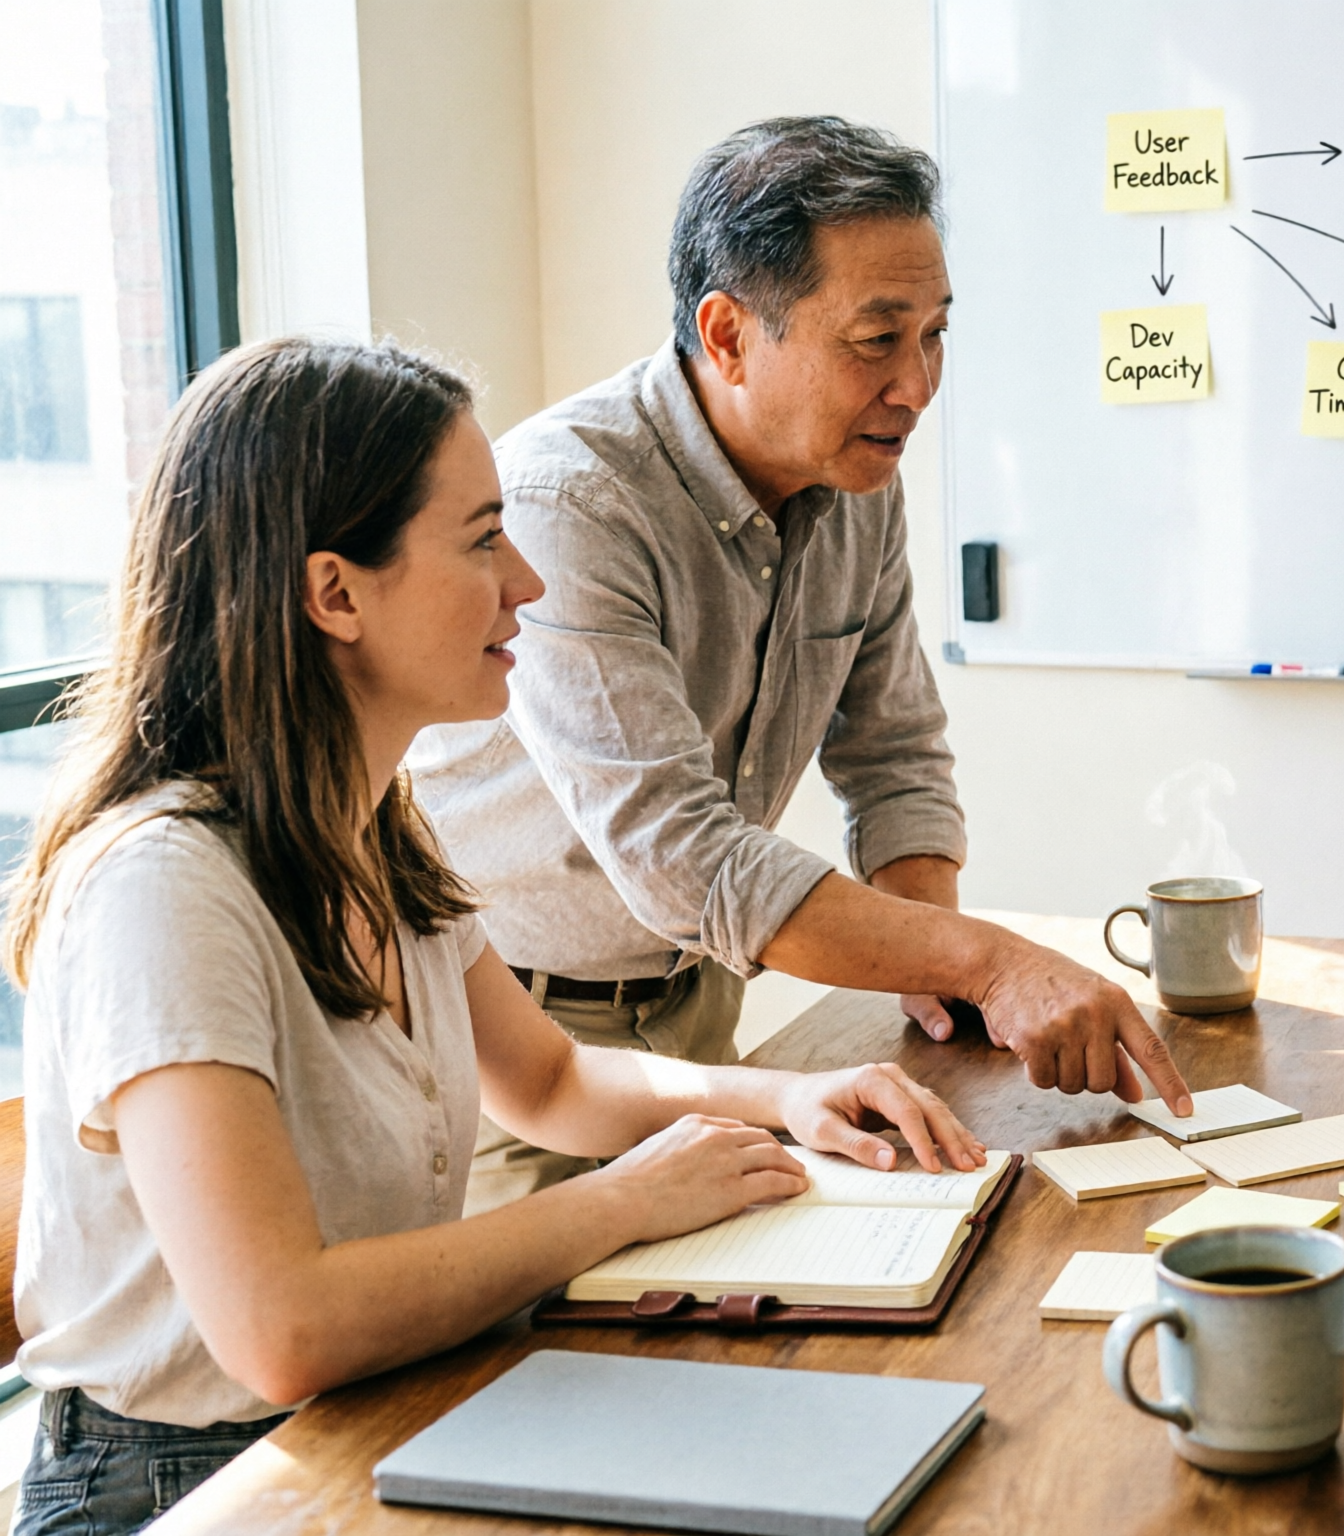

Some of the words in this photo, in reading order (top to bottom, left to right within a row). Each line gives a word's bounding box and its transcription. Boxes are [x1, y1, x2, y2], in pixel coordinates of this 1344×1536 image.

[1135, 129, 1189, 155] User
[1113, 159, 1219, 189] Feedback
[1130, 323, 1174, 349] Dev
[1106, 356, 1203, 390] Capacity
